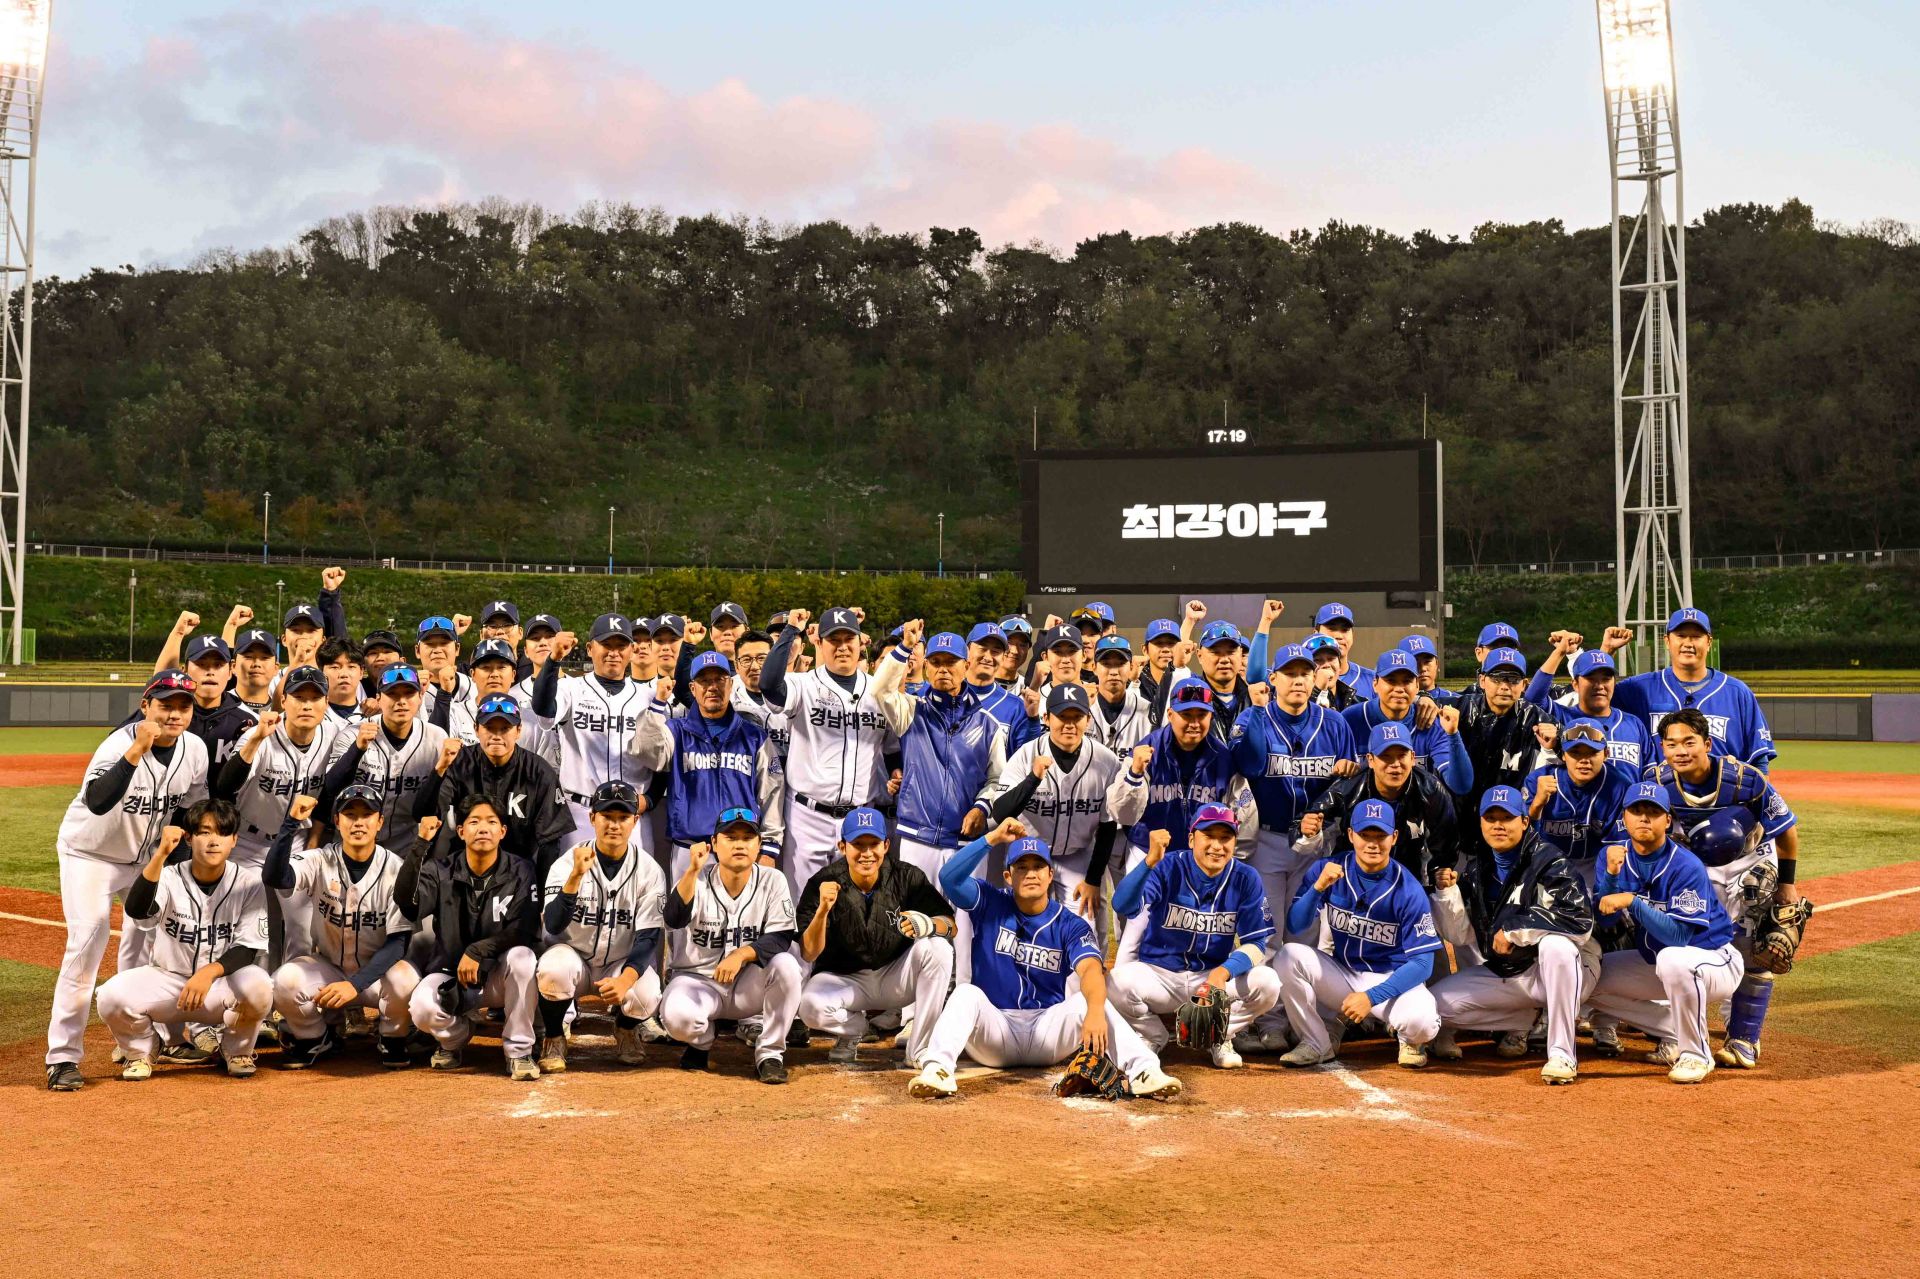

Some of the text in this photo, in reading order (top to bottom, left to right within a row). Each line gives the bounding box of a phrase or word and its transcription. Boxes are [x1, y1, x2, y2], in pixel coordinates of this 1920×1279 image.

[1207, 429, 1247, 443] 17:19
[1121, 501, 1328, 539] 최강야구
[299, 605, 311, 616] K
[494, 601, 508, 612] K
[721, 603, 733, 613] K
[1095, 604, 1106, 616] M
[1331, 605, 1345, 616] M
[535, 614, 549, 622] K
[660, 615, 673, 625] K
[833, 611, 848, 624] K
[1682, 609, 1698, 621] M
[609, 617, 622, 631] K
[635, 617, 649, 627] K
[1158, 620, 1172, 631] M
[251, 630, 265, 641] K
[987, 623, 1001, 635] M
[1058, 626, 1071, 638] K
[1496, 624, 1510, 637] M
[203, 635, 219, 648] K
[486, 639, 500, 651] K
[937, 635, 953, 647] M
[1408, 637, 1425, 651] M
[1288, 645, 1304, 657] M
[1500, 649, 1515, 662] M
[703, 653, 718, 665] M
[1391, 652, 1407, 665] M
[1590, 652, 1607, 664] M
[1063, 686, 1077, 701] K
[1383, 725, 1400, 740] M
[215, 738, 234, 764] K
[683, 751, 753, 777] MONSTERS
[1500, 748, 1523, 772] M
[354, 768, 429, 795] 경남대학
[1491, 789, 1508, 802] M
[1639, 784, 1656, 798] M
[122, 794, 186, 816] 경남대학
[508, 791, 528, 819] K
[1365, 804, 1382, 819] M
[857, 812, 873, 827] M
[1022, 839, 1038, 851] M
[1755, 842, 1773, 857] 53
[492, 894, 514, 922] K
[165, 917, 237, 946] 경남대학
[692, 925, 765, 949] 경남대학
[997, 929, 1062, 972] MOSTERS
